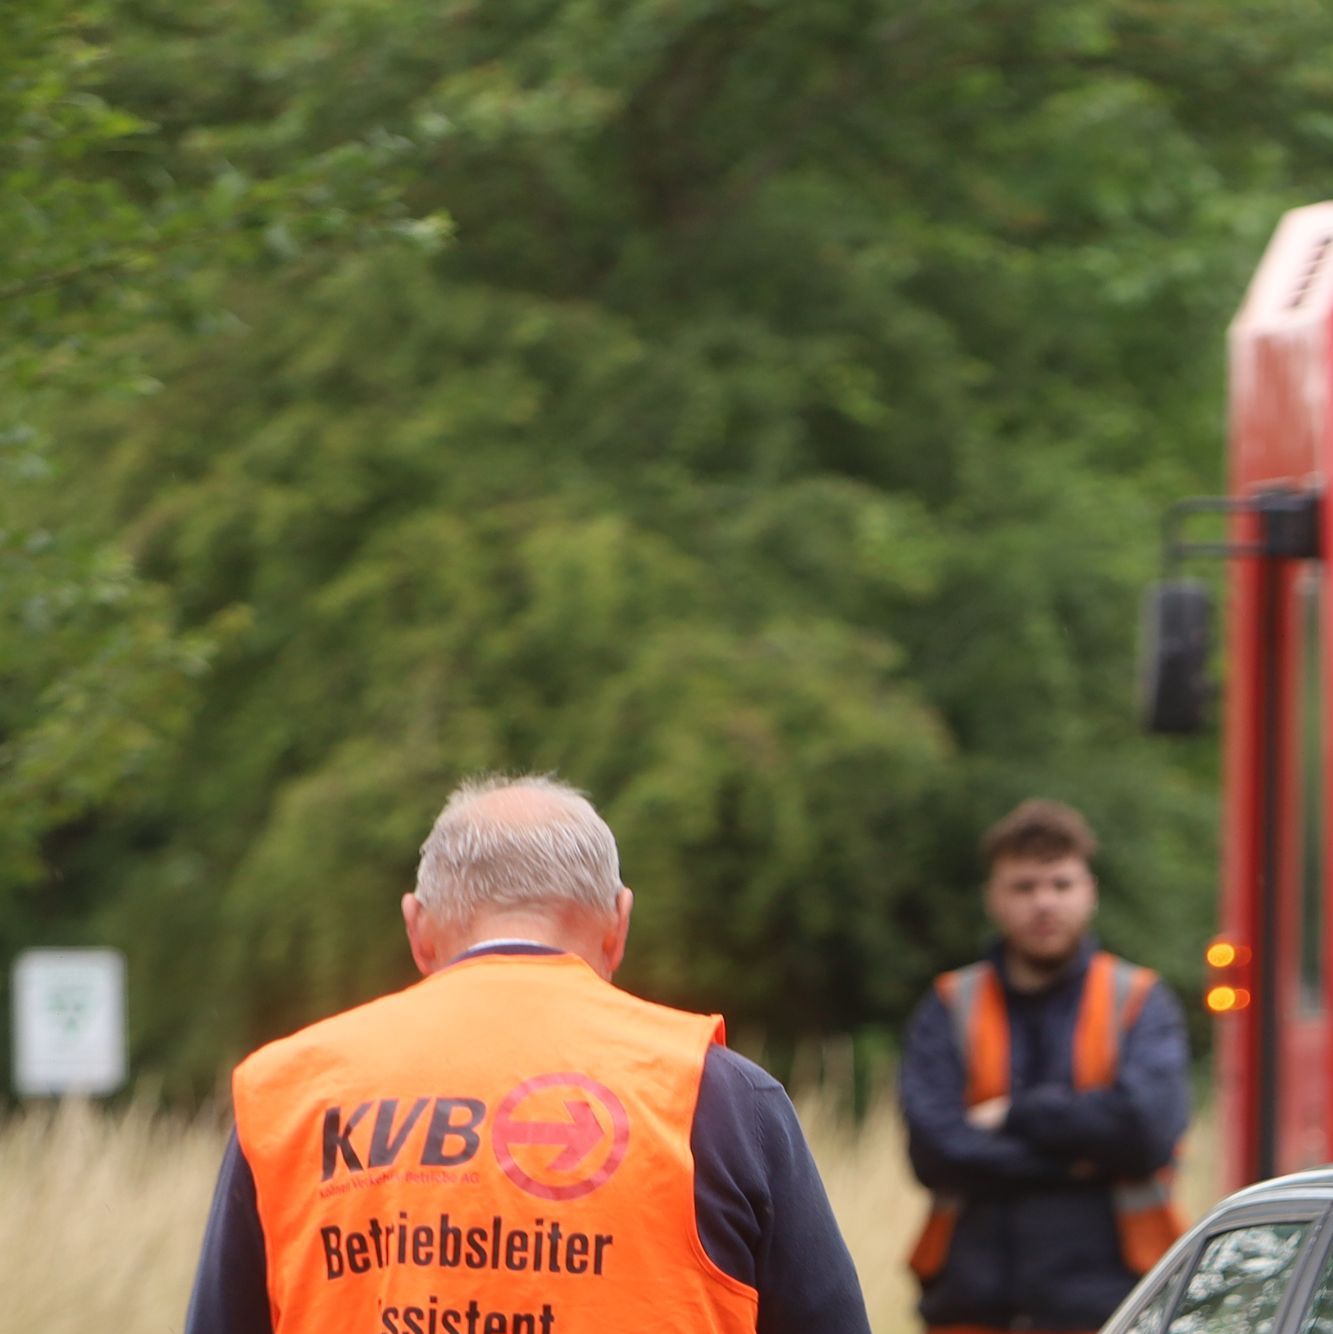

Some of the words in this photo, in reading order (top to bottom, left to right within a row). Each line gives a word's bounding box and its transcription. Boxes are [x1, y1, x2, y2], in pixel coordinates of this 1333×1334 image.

[321, 1097, 487, 1183] KVB
[461, 1170, 482, 1184] AG
[320, 1211, 613, 1281] Betriebsleiter
